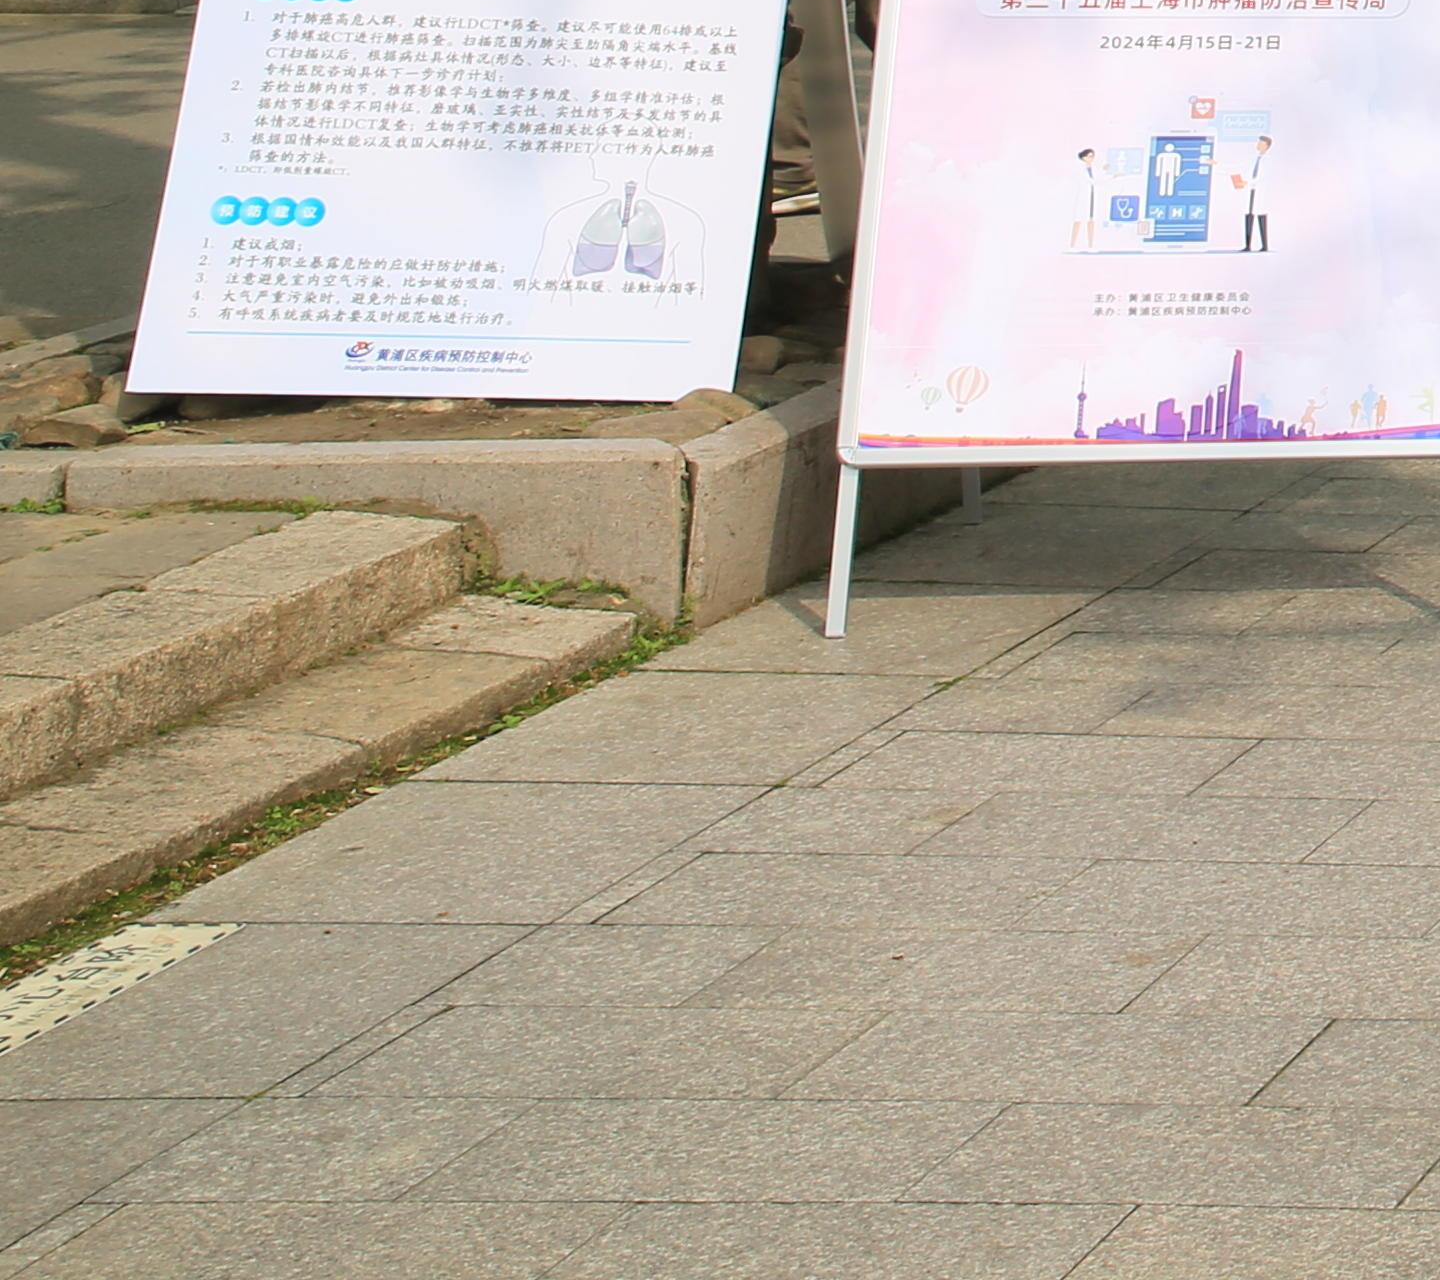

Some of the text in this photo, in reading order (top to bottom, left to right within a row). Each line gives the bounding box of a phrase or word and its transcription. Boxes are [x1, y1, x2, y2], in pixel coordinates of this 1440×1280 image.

[1099, 34, 1282, 51] 2024年4月15日-21日
[376, 348, 533, 365] 黄浦区疾病预防控制中心
